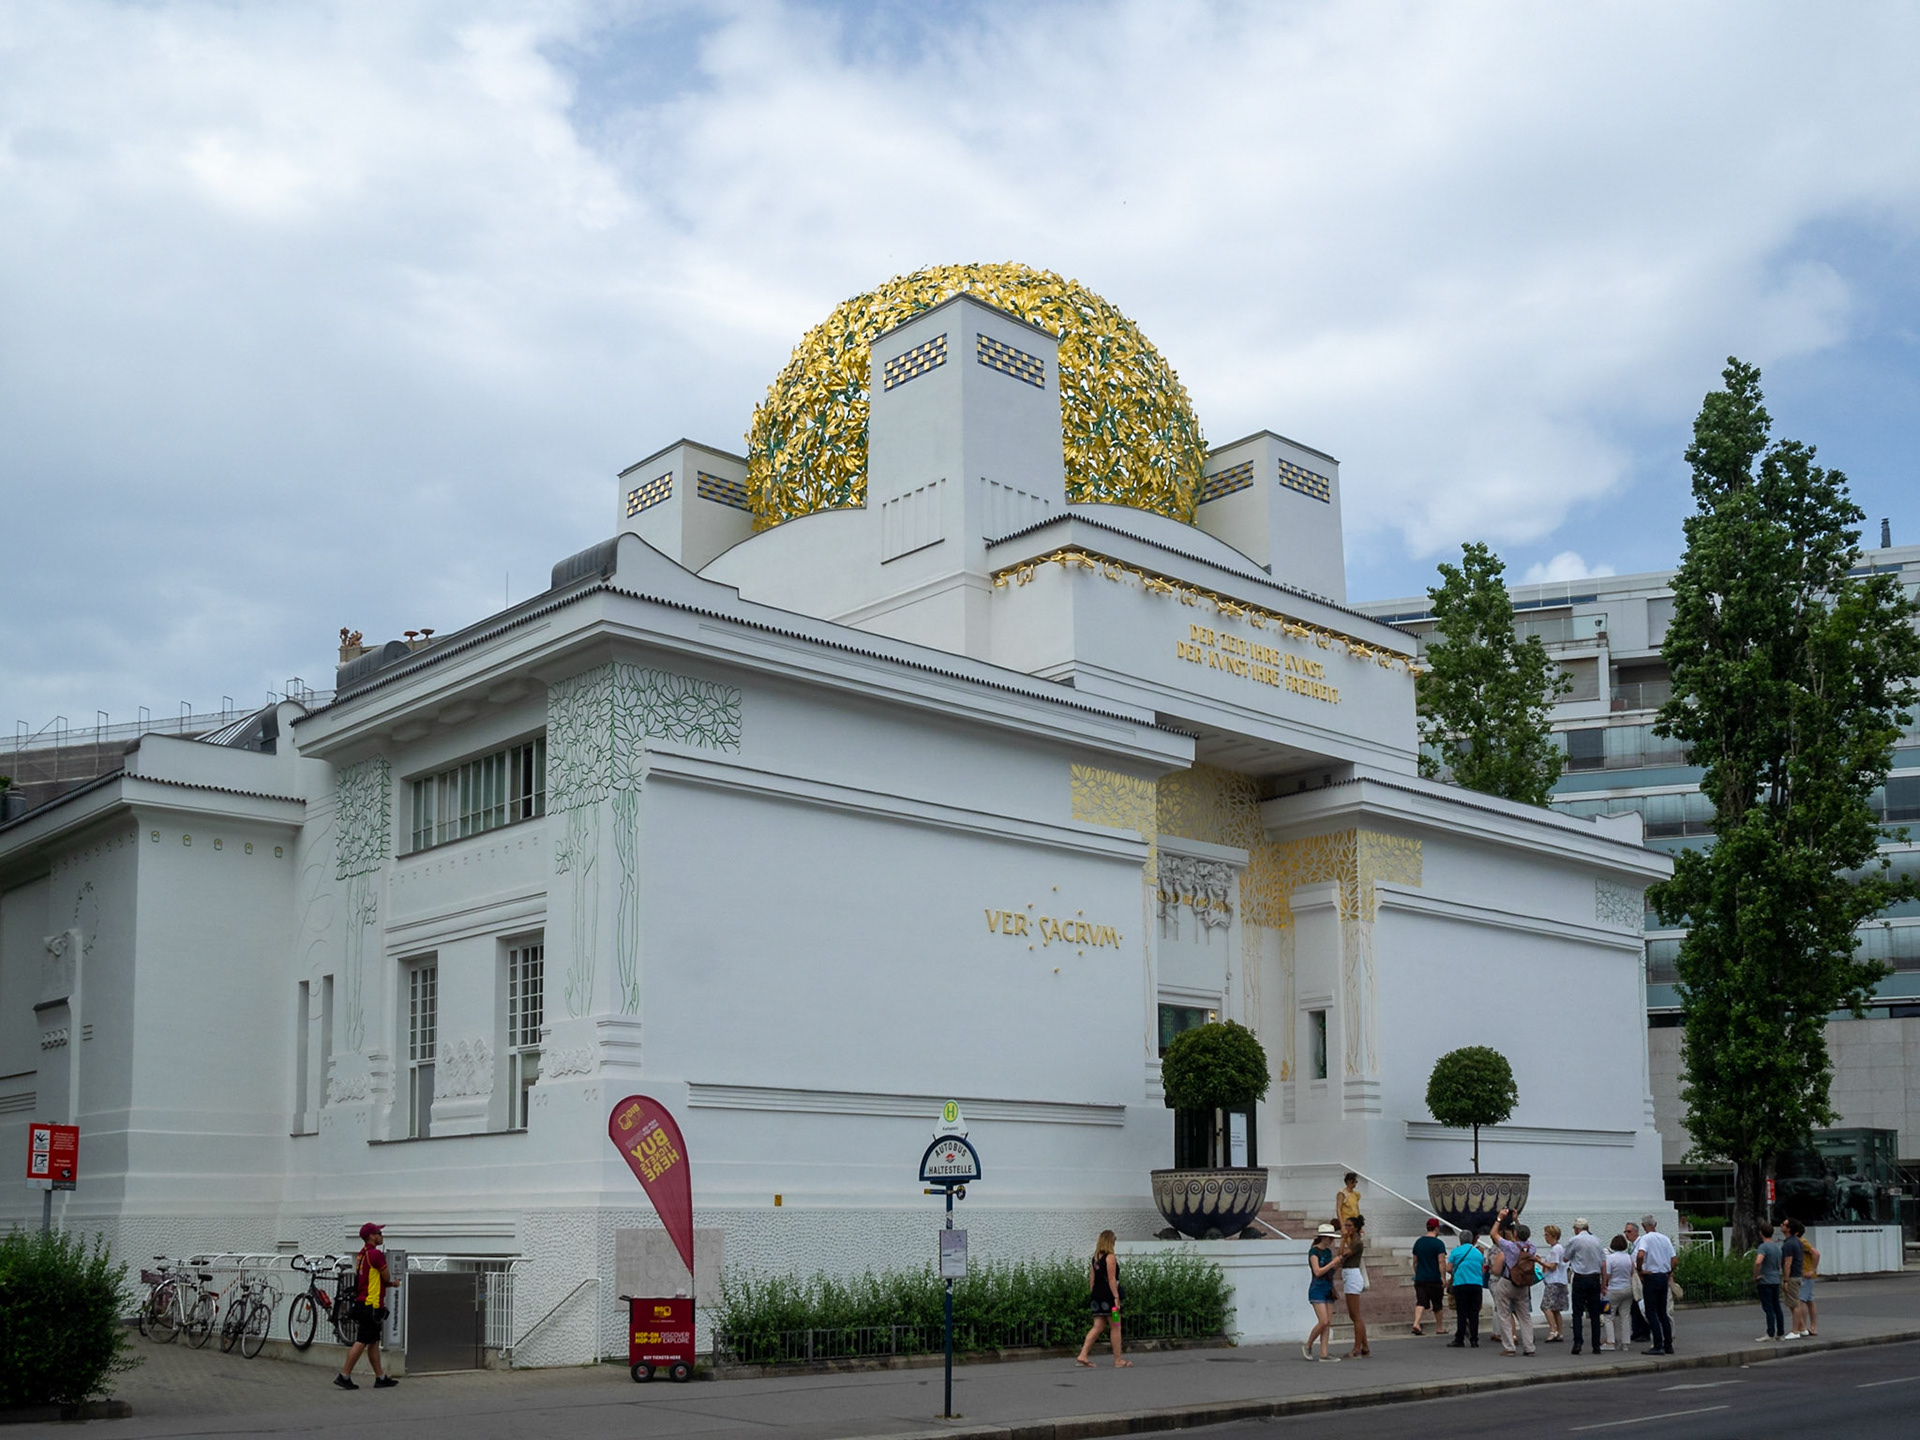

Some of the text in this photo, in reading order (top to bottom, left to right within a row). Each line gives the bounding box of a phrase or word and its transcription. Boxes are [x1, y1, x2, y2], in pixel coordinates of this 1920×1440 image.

[946, 1105, 955, 1119] H
[934, 1142, 968, 1158] AUTOBUS
[928, 1164, 972, 1175] HALTESTELLE
